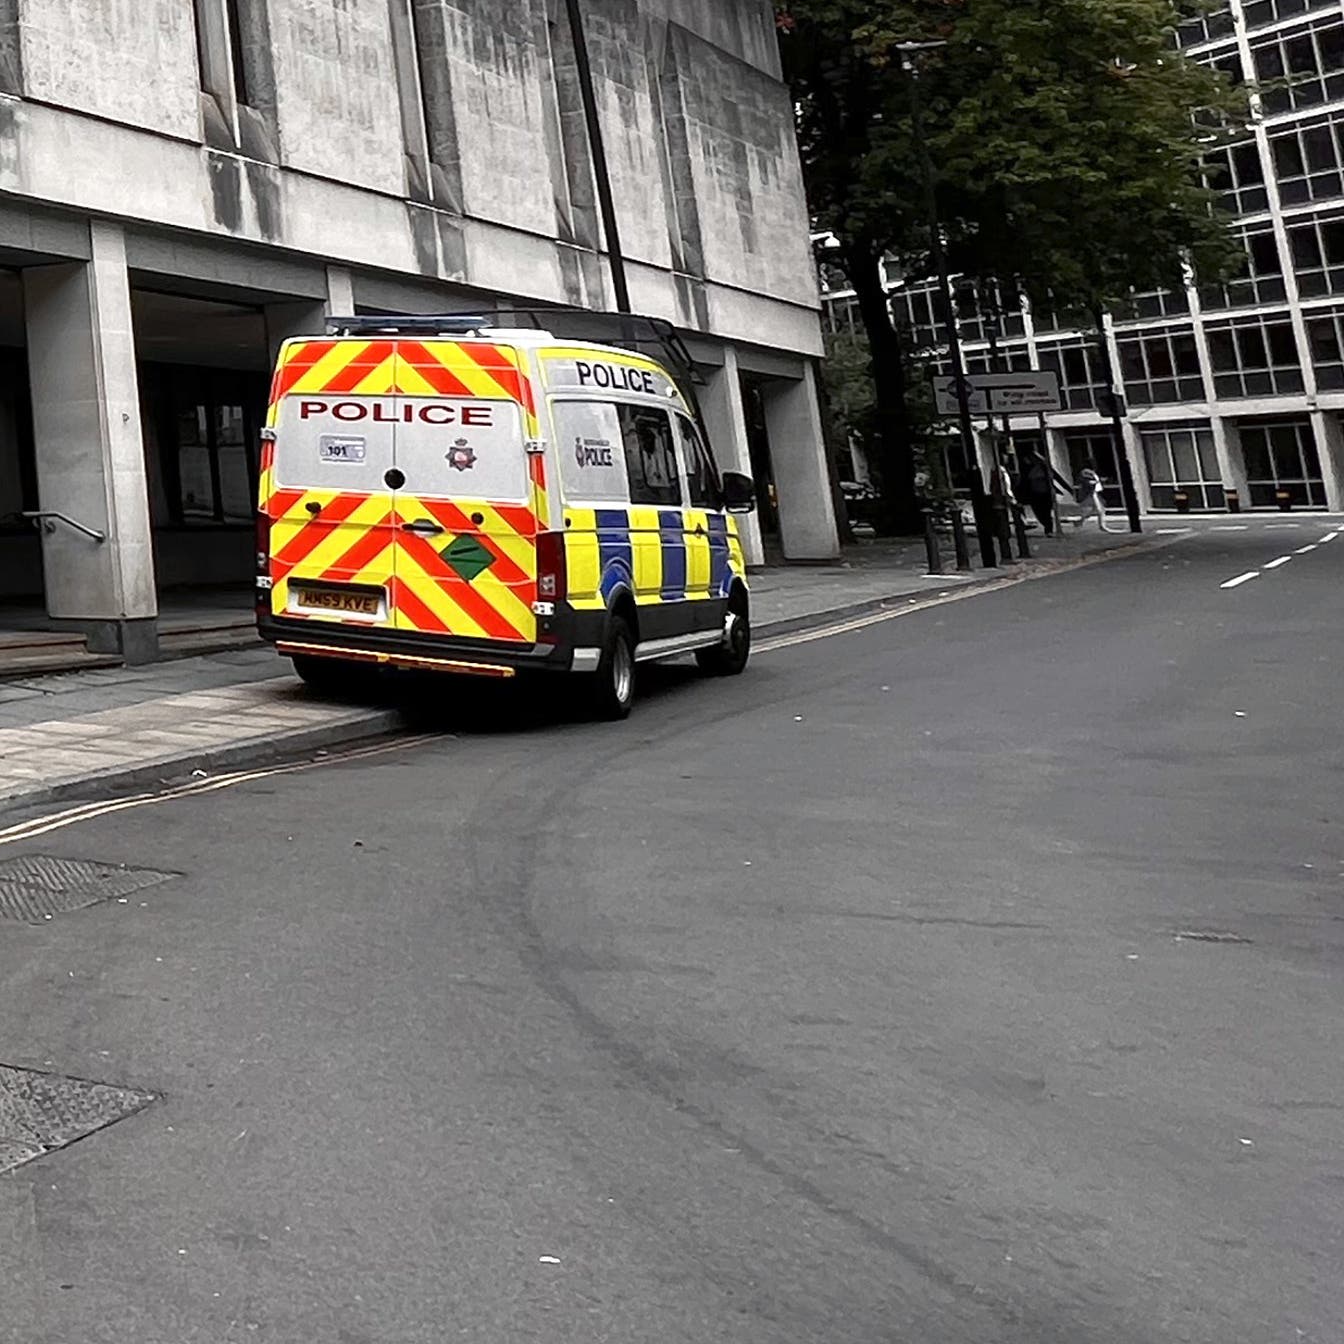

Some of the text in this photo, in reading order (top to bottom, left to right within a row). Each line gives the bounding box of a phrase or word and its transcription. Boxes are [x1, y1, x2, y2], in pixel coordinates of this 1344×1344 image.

[575, 361, 656, 394] POLICE
[300, 401, 493, 427] POLICE
[584, 447, 613, 467] POLICE
